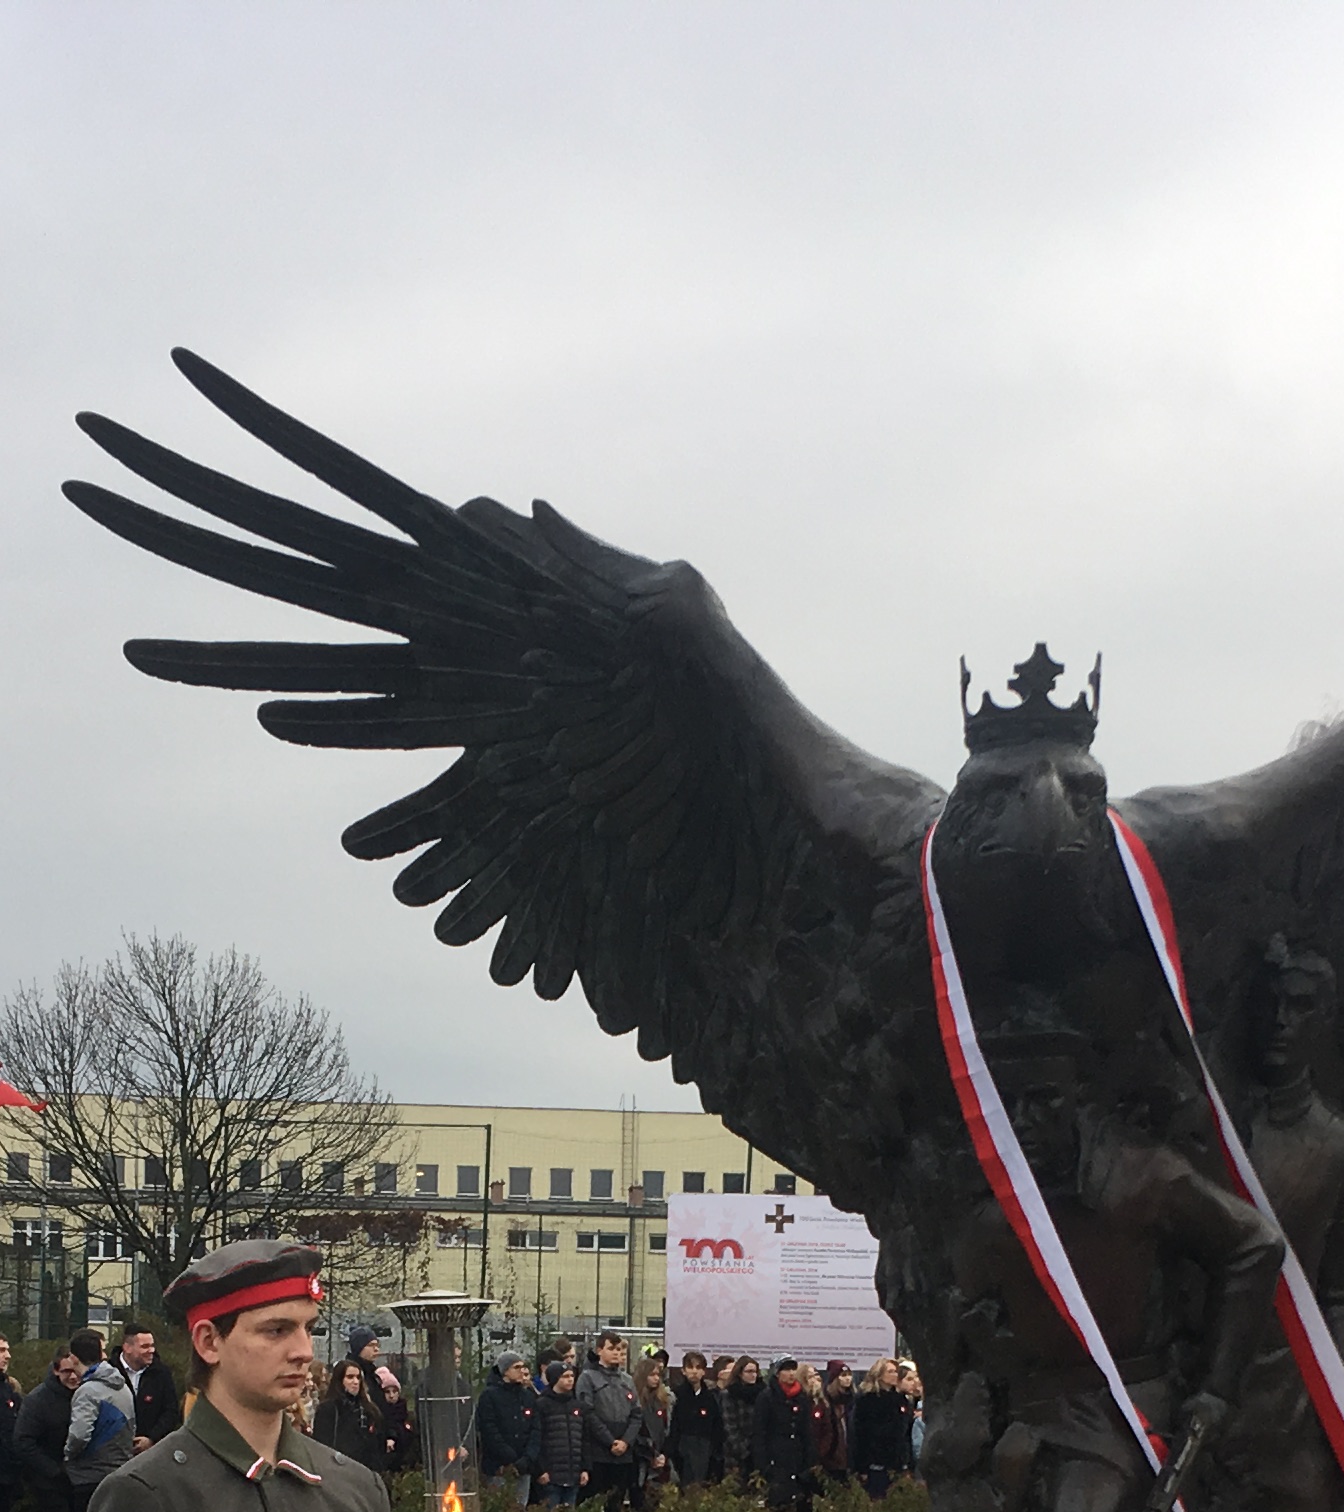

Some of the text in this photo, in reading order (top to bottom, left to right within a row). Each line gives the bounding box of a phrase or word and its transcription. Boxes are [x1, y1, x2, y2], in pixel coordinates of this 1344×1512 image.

[678, 1238, 744, 1259] 100
[682, 1259, 755, 1268] POWSTANIA
[683, 1266, 755, 1275] WIELKOPOLSKIEGO
